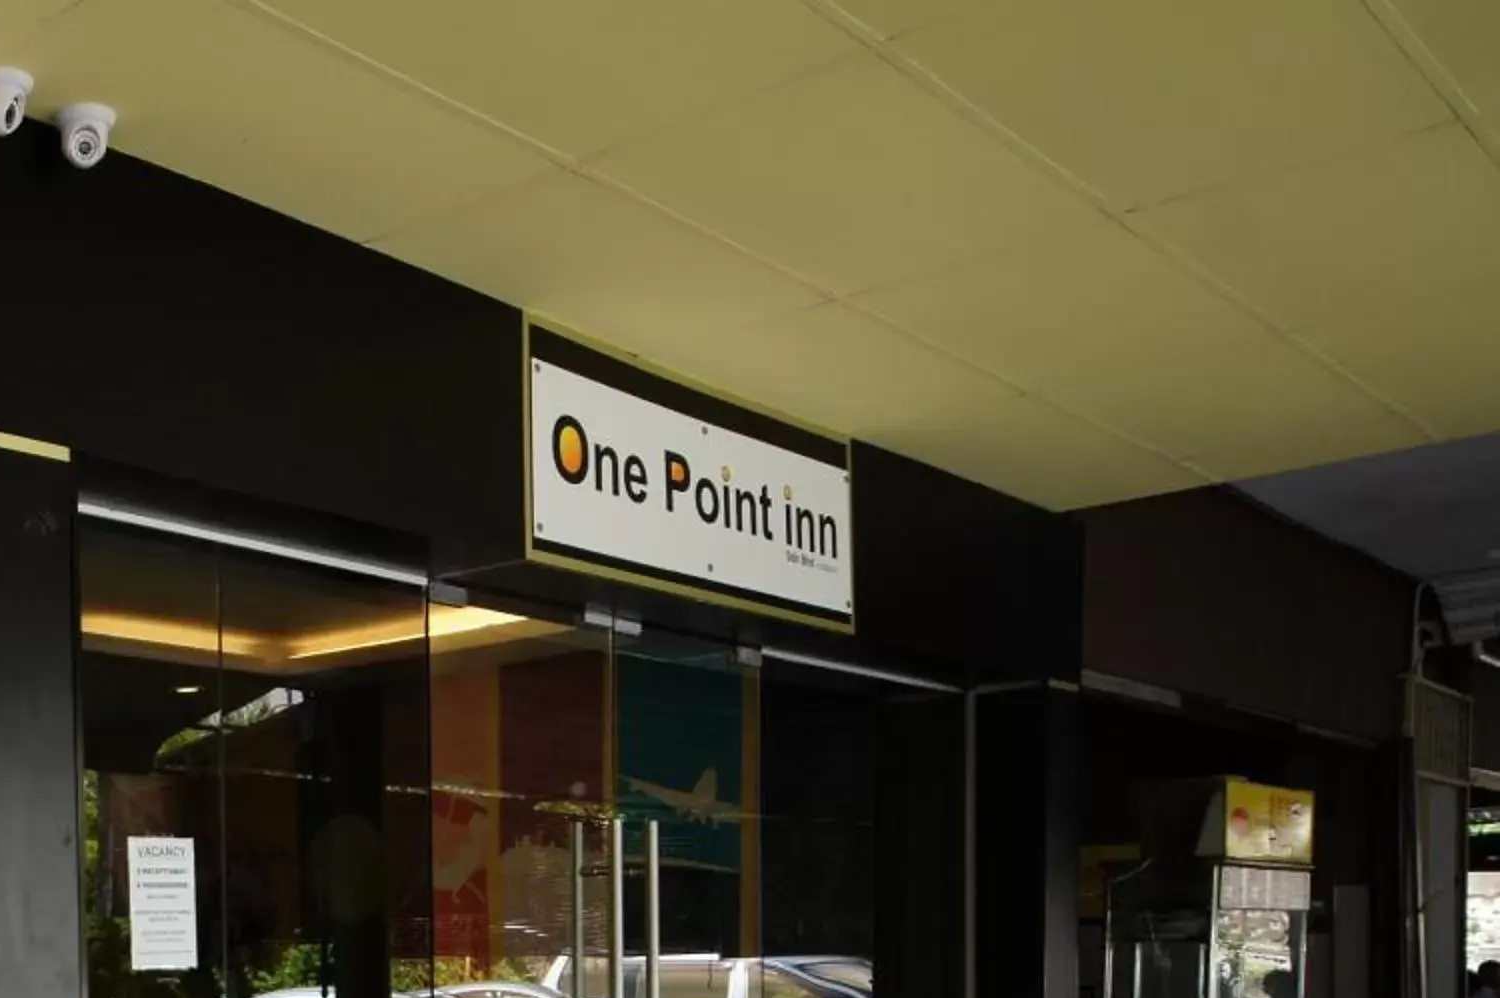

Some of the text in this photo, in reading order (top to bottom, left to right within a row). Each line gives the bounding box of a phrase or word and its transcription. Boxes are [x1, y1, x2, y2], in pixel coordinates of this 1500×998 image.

[552, 414, 838, 559] One Point inn
[137, 845, 187, 858] VACANCY
